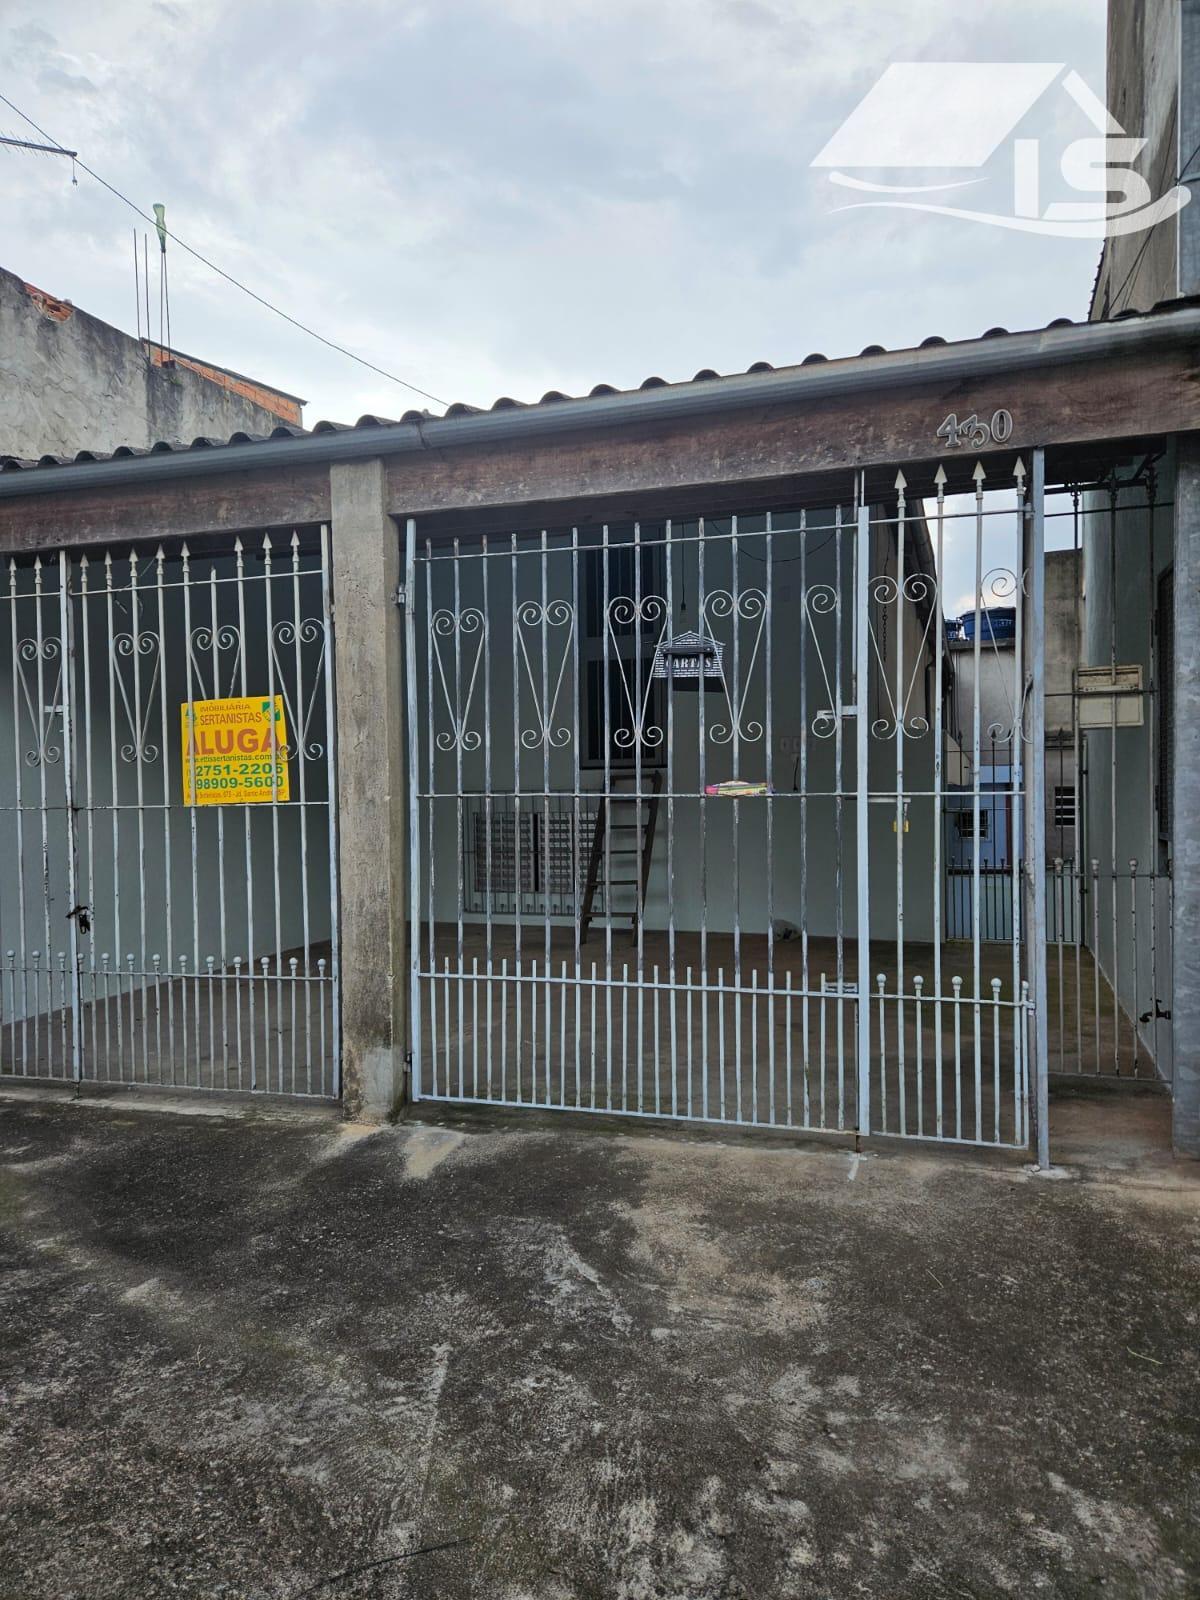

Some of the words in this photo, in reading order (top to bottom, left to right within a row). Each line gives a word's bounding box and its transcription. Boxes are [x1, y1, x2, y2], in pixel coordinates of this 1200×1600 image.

[936, 408, 1013, 450] 430
[200, 711, 263, 726] SERTANISTAS
[187, 727, 283, 756] ALUGA
[196, 775, 284, 790] 98909-5600
